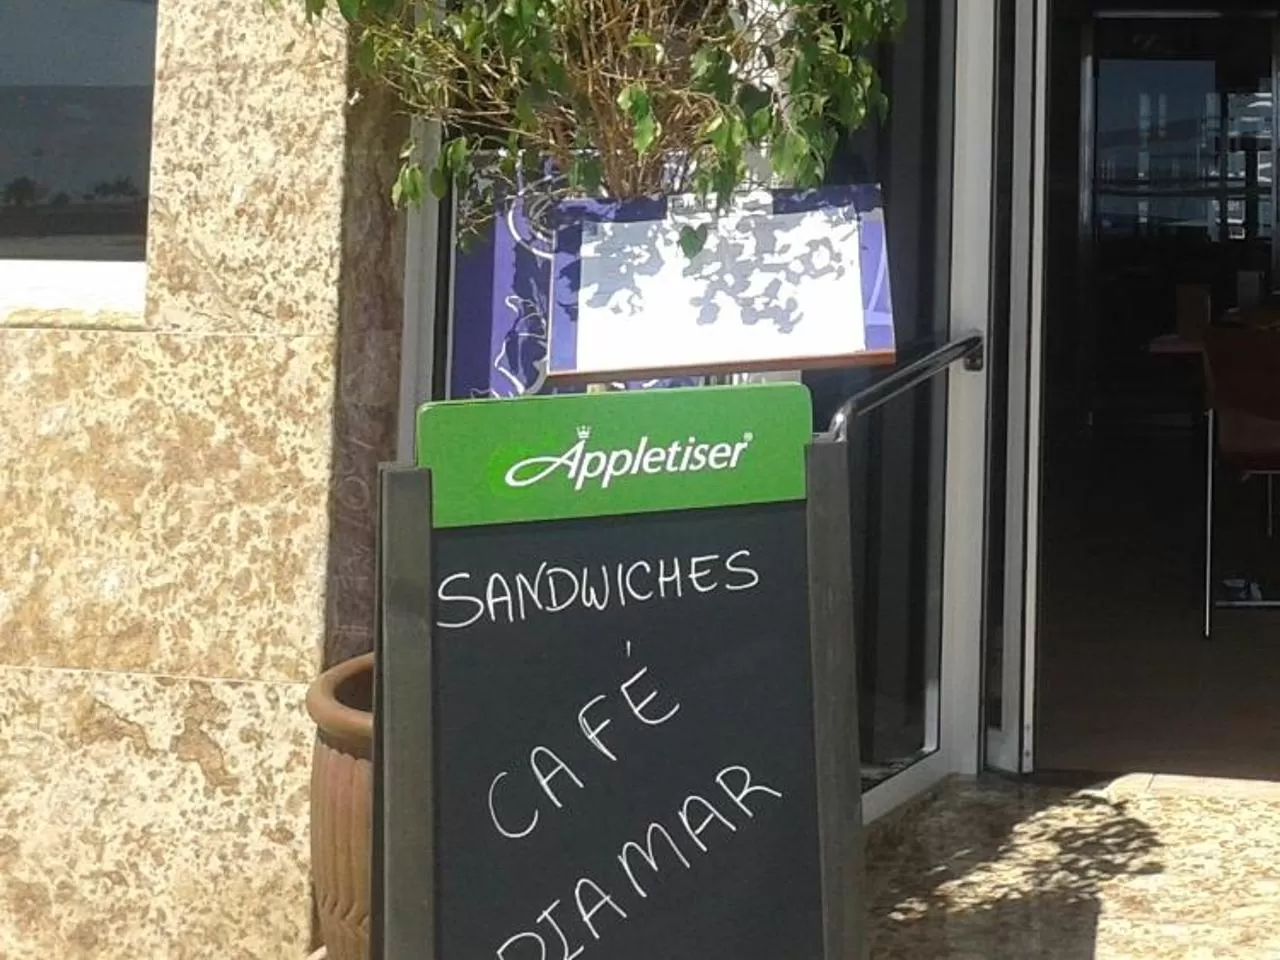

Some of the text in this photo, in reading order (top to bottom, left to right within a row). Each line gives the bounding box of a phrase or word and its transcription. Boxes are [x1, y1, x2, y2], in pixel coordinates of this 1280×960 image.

[505, 433, 751, 490] Appletiser
[437, 549, 760, 629] SANDWICHES
[488, 640, 681, 839] CAFÉ
